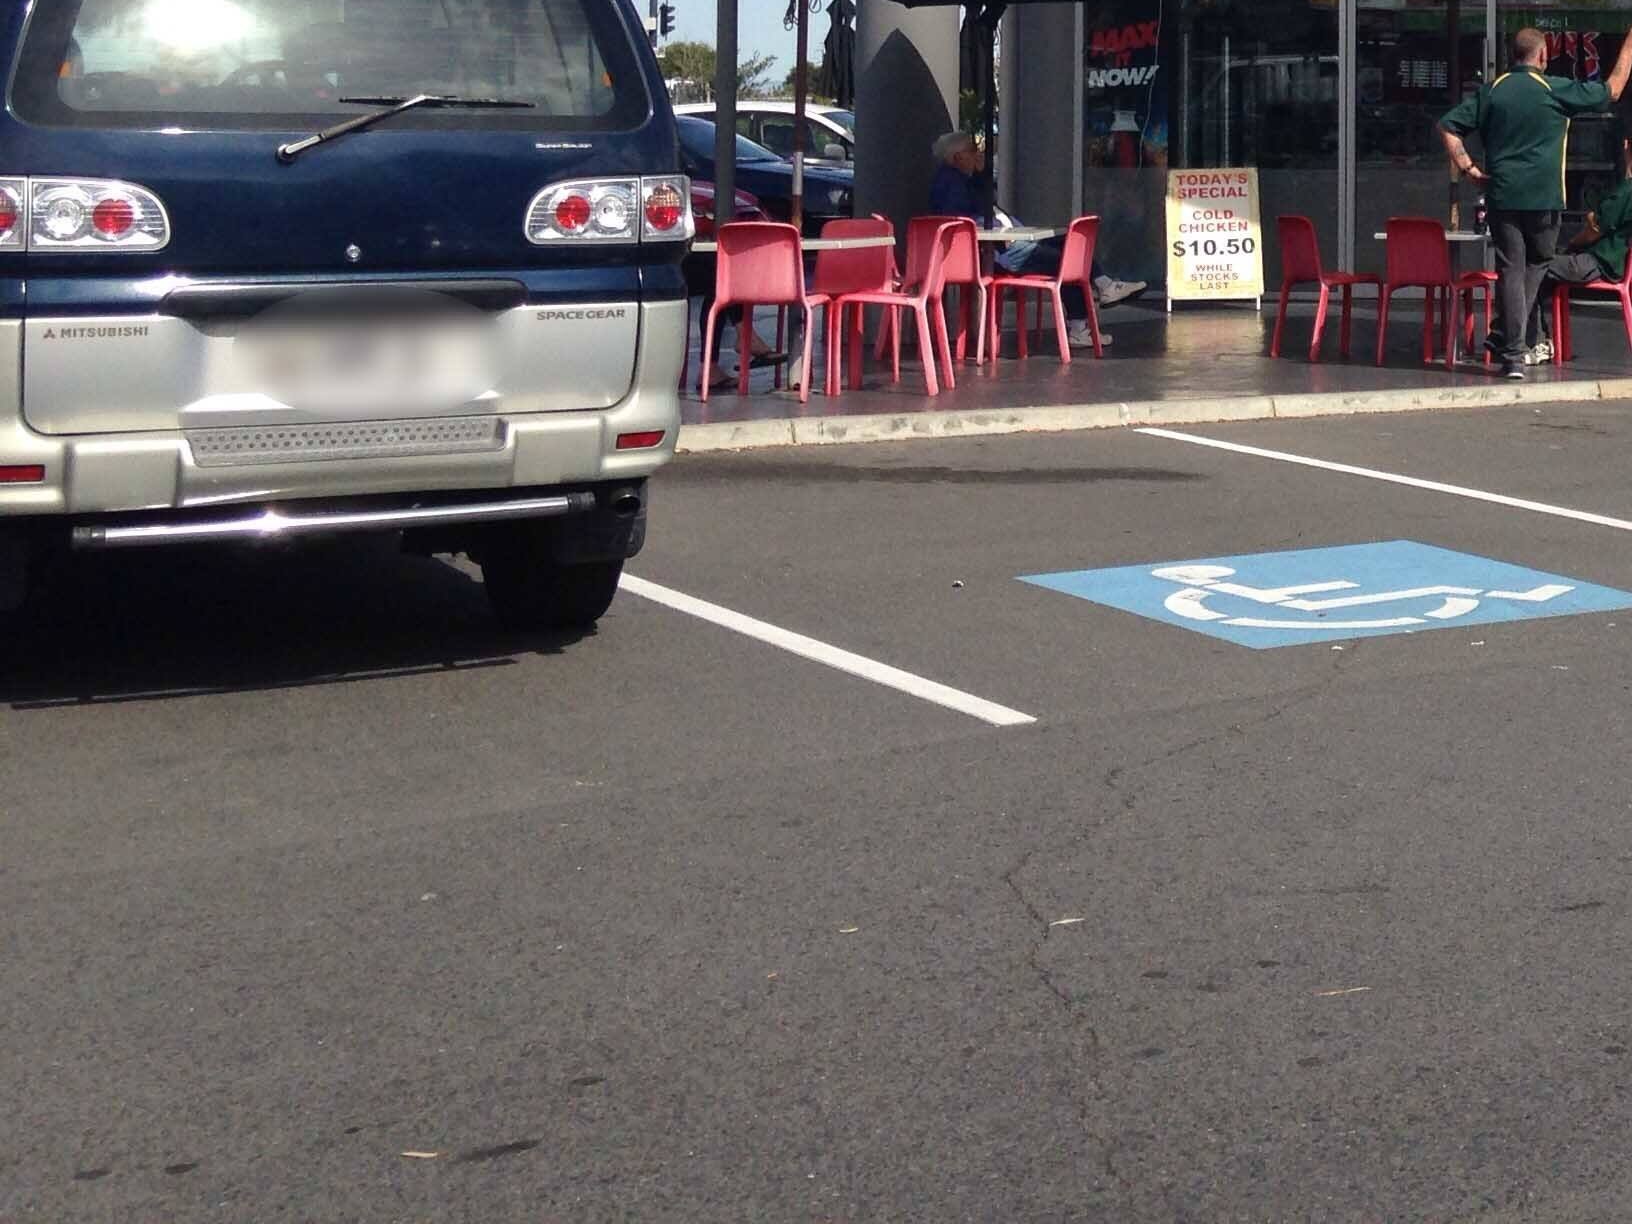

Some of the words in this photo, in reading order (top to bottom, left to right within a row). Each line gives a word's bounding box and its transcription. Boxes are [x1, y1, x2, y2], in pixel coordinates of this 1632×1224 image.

[1088, 64, 1160, 89] NOW!
[1176, 173, 1249, 186] TODAY'S
[1177, 187, 1247, 200] SPECIAL
[1192, 209, 1234, 221] COLD
[1178, 221, 1248, 233] CHICKEN
[1172, 237, 1256, 257] $10.50
[1195, 263, 1233, 272] WHILE
[1191, 272, 1240, 282] STOCKS
[1199, 281, 1230, 291] LAST
[60, 326, 149, 339] MITSUBISHI
